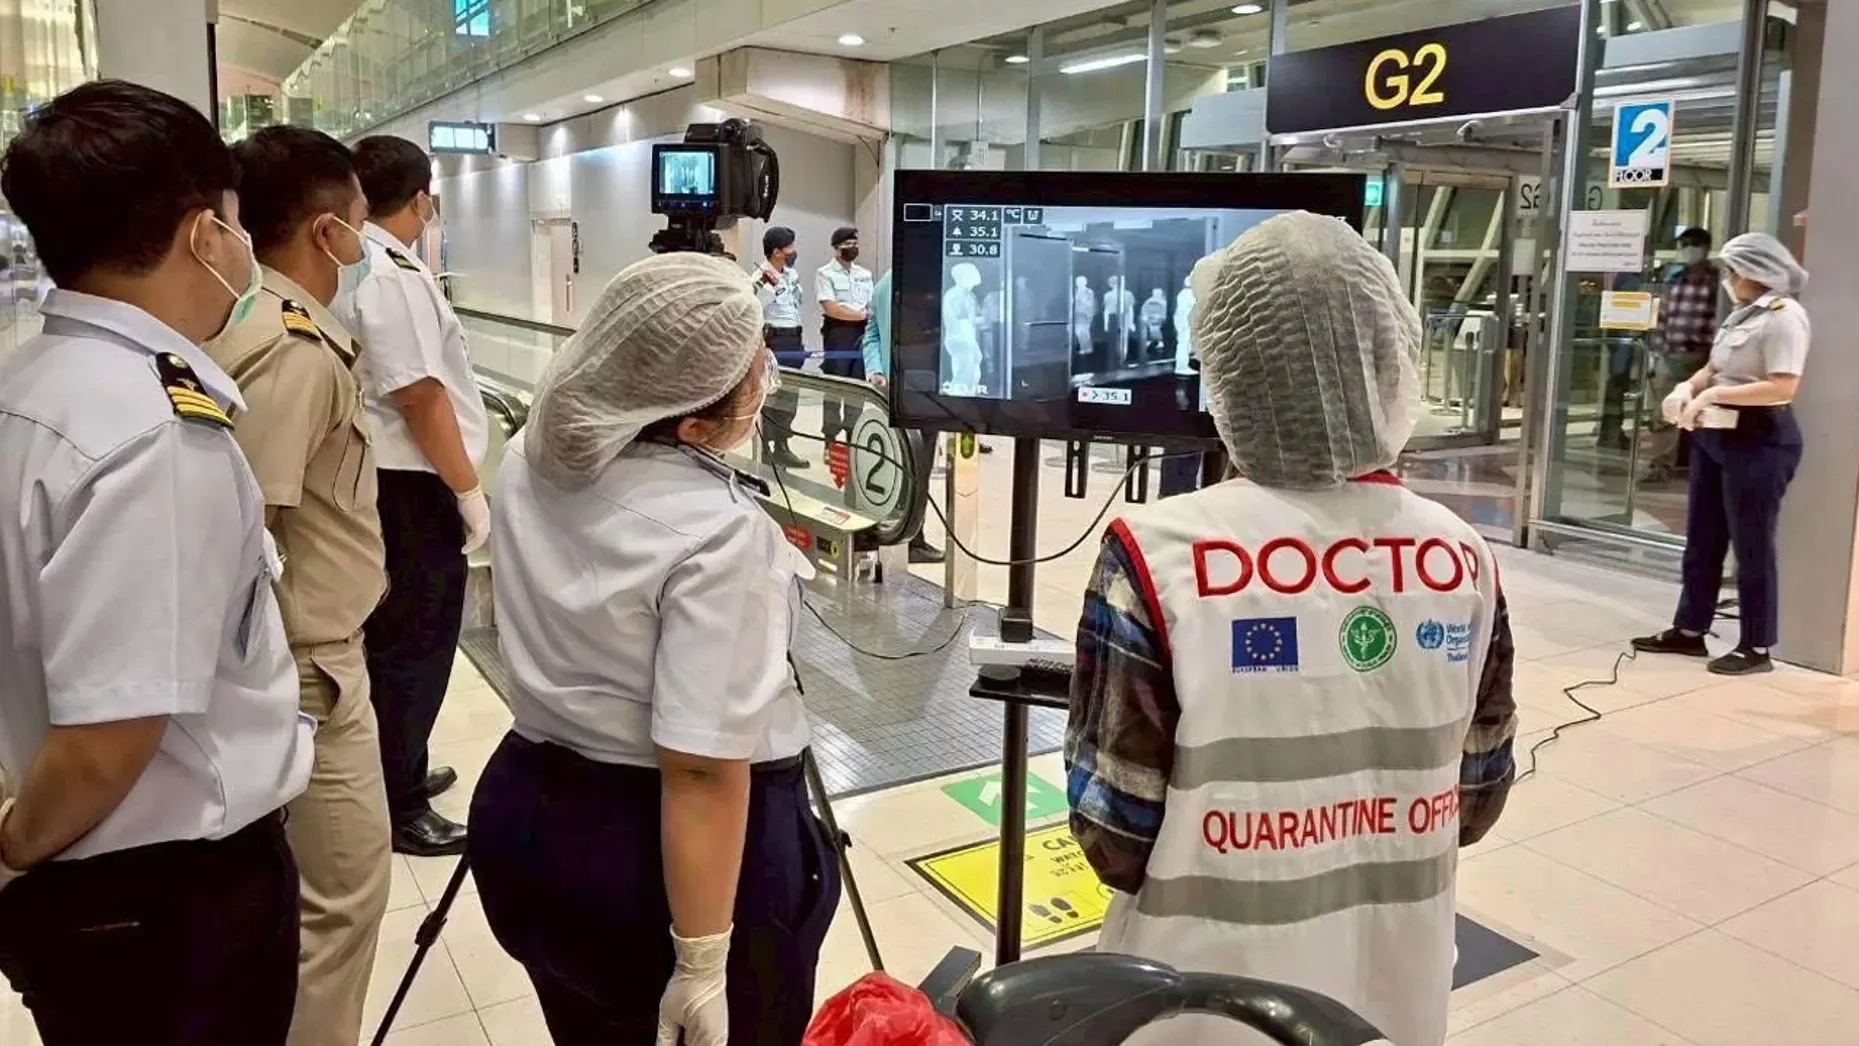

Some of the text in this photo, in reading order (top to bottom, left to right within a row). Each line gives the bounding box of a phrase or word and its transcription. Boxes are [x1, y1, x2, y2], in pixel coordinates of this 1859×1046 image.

[1364, 43, 1447, 110] G2
[1627, 109, 1669, 167] 2
[969, 209, 999, 221] 34.1
[969, 226, 999, 238] 35.1
[969, 243, 999, 255] 30.8
[865, 432, 886, 495] 2
[1202, 797, 1398, 855] QUARANTINE
